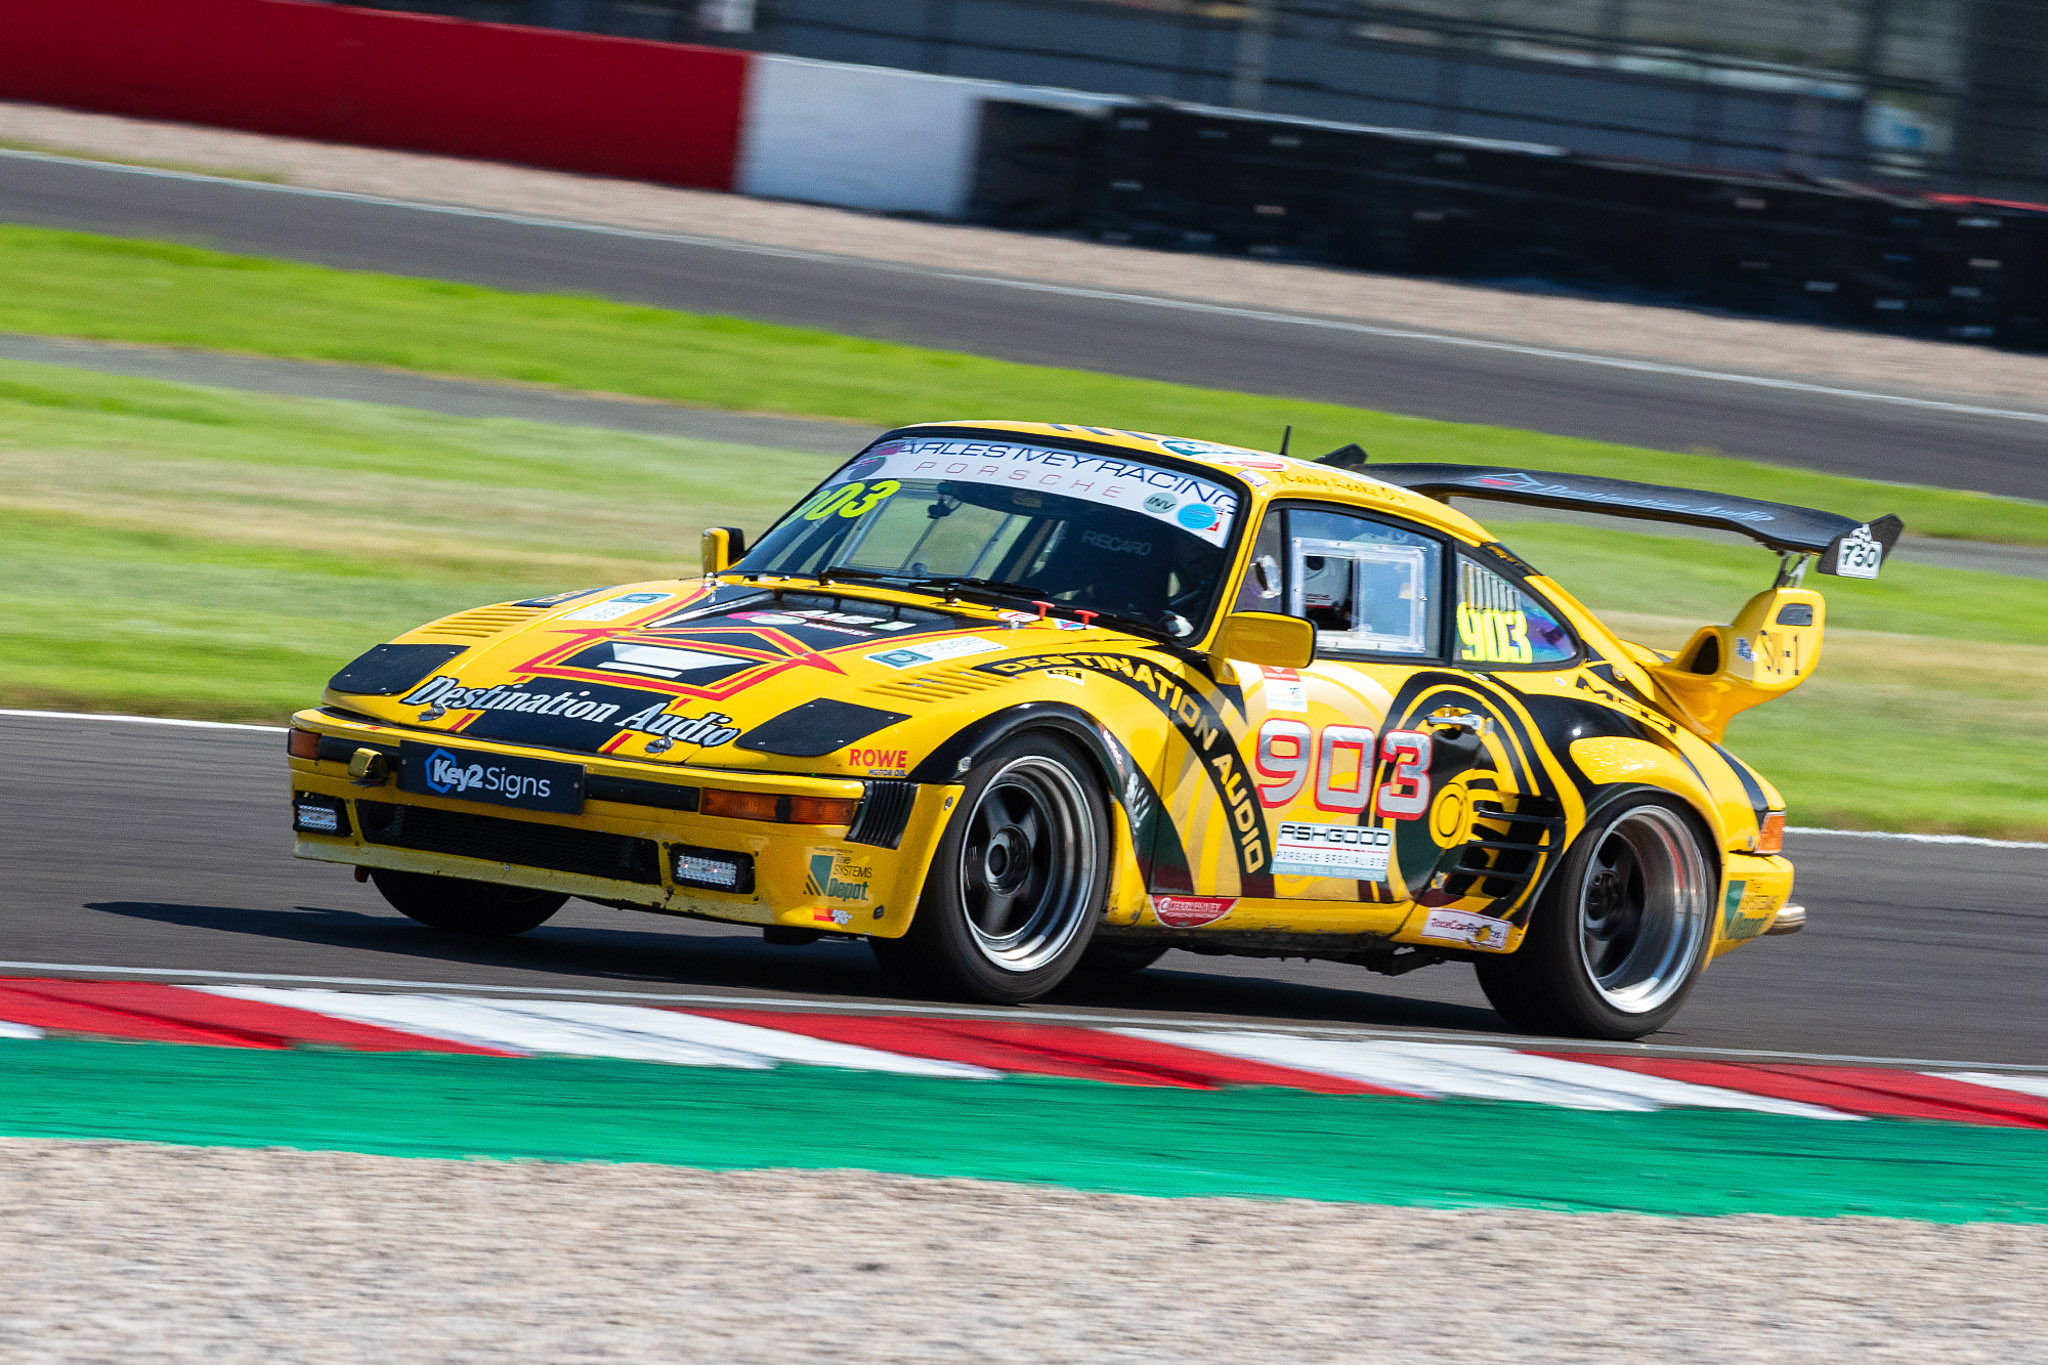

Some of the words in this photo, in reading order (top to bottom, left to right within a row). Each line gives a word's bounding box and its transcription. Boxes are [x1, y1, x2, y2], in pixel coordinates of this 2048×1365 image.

[913, 461, 1125, 499] PORSCHE
[1012, 447, 1091, 469] IVEY
[1094, 460, 1239, 516] RACING
[1456, 602, 1533, 664] 903
[402, 676, 620, 723] Destination
[615, 702, 740, 747] Audio
[848, 748, 908, 769] ROWE
[992, 655, 1219, 751] DESTINATION
[1213, 753, 1264, 874] AUDIO
[1256, 718, 1433, 820] 903
[1280, 824, 1392, 846] ASHGOOD
[827, 878, 869, 902] Depot
[833, 864, 873, 879] SYSTEMS
